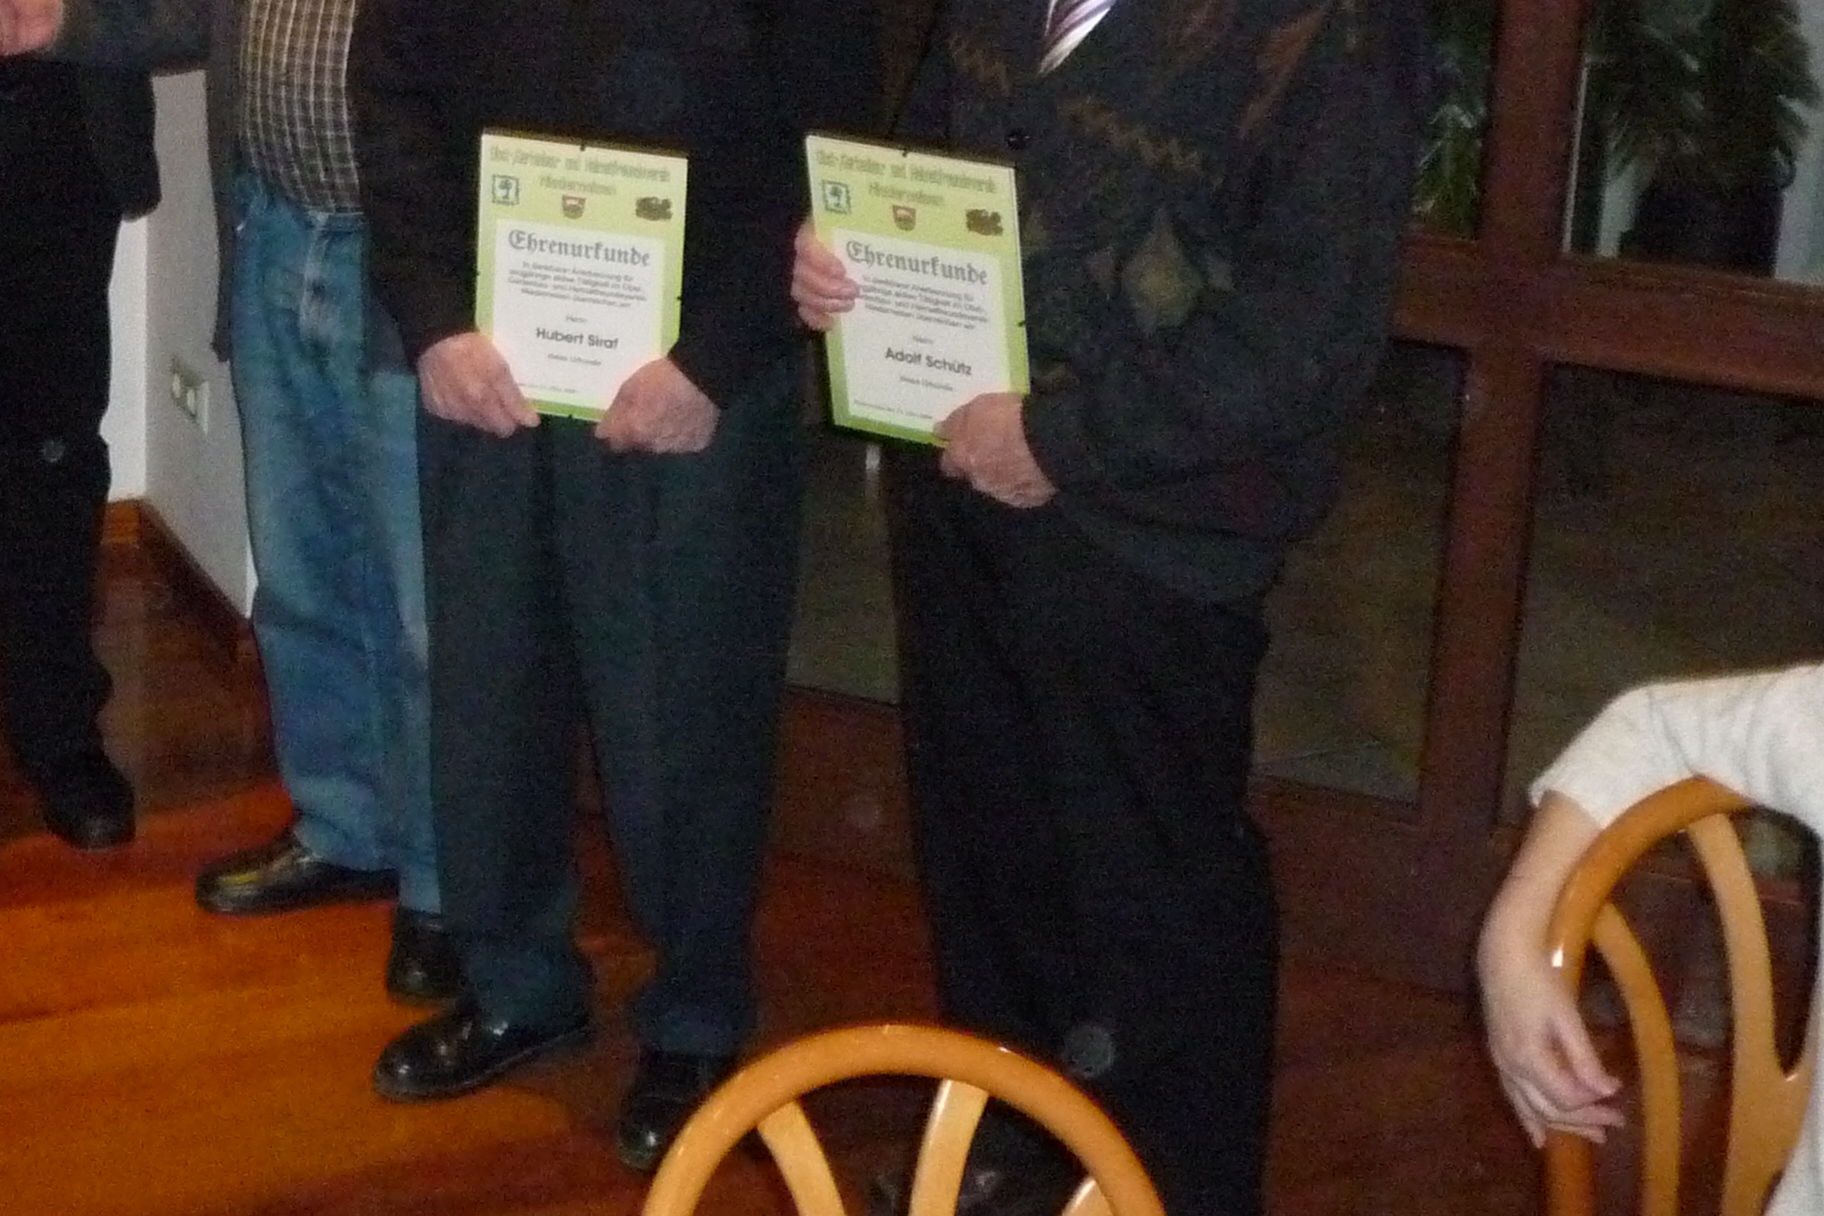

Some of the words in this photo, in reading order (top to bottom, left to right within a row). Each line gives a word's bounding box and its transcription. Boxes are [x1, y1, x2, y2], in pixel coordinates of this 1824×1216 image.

[508, 229, 650, 267] Ehrenurkunde
[846, 240, 988, 285] Ehrenurkunde
[536, 327, 584, 344] Hubert
[885, 347, 922, 364] Adolf
